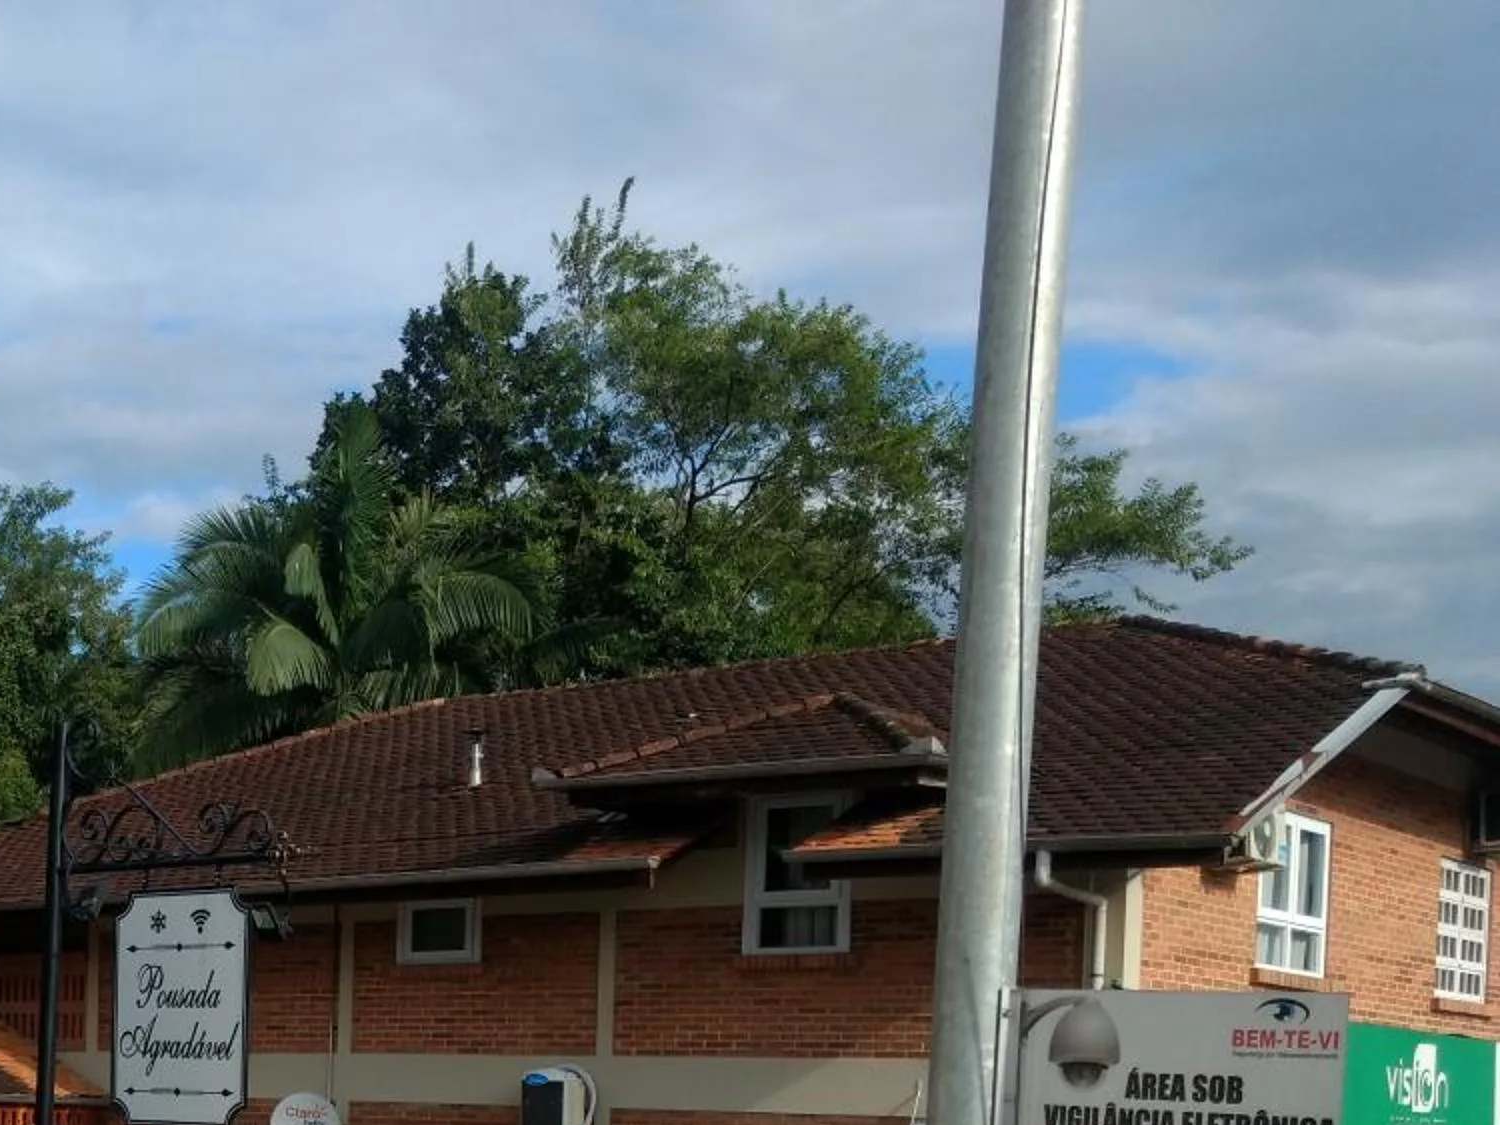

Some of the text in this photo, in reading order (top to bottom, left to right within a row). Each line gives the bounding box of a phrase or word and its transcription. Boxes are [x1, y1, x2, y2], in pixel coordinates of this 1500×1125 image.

[136, 963, 221, 1009] Pousada
[119, 1014, 240, 1076] Agradável
[1232, 1029, 1339, 1049] BEM-TE-VI
[1125, 1067, 1244, 1104] ÁREA SOB
